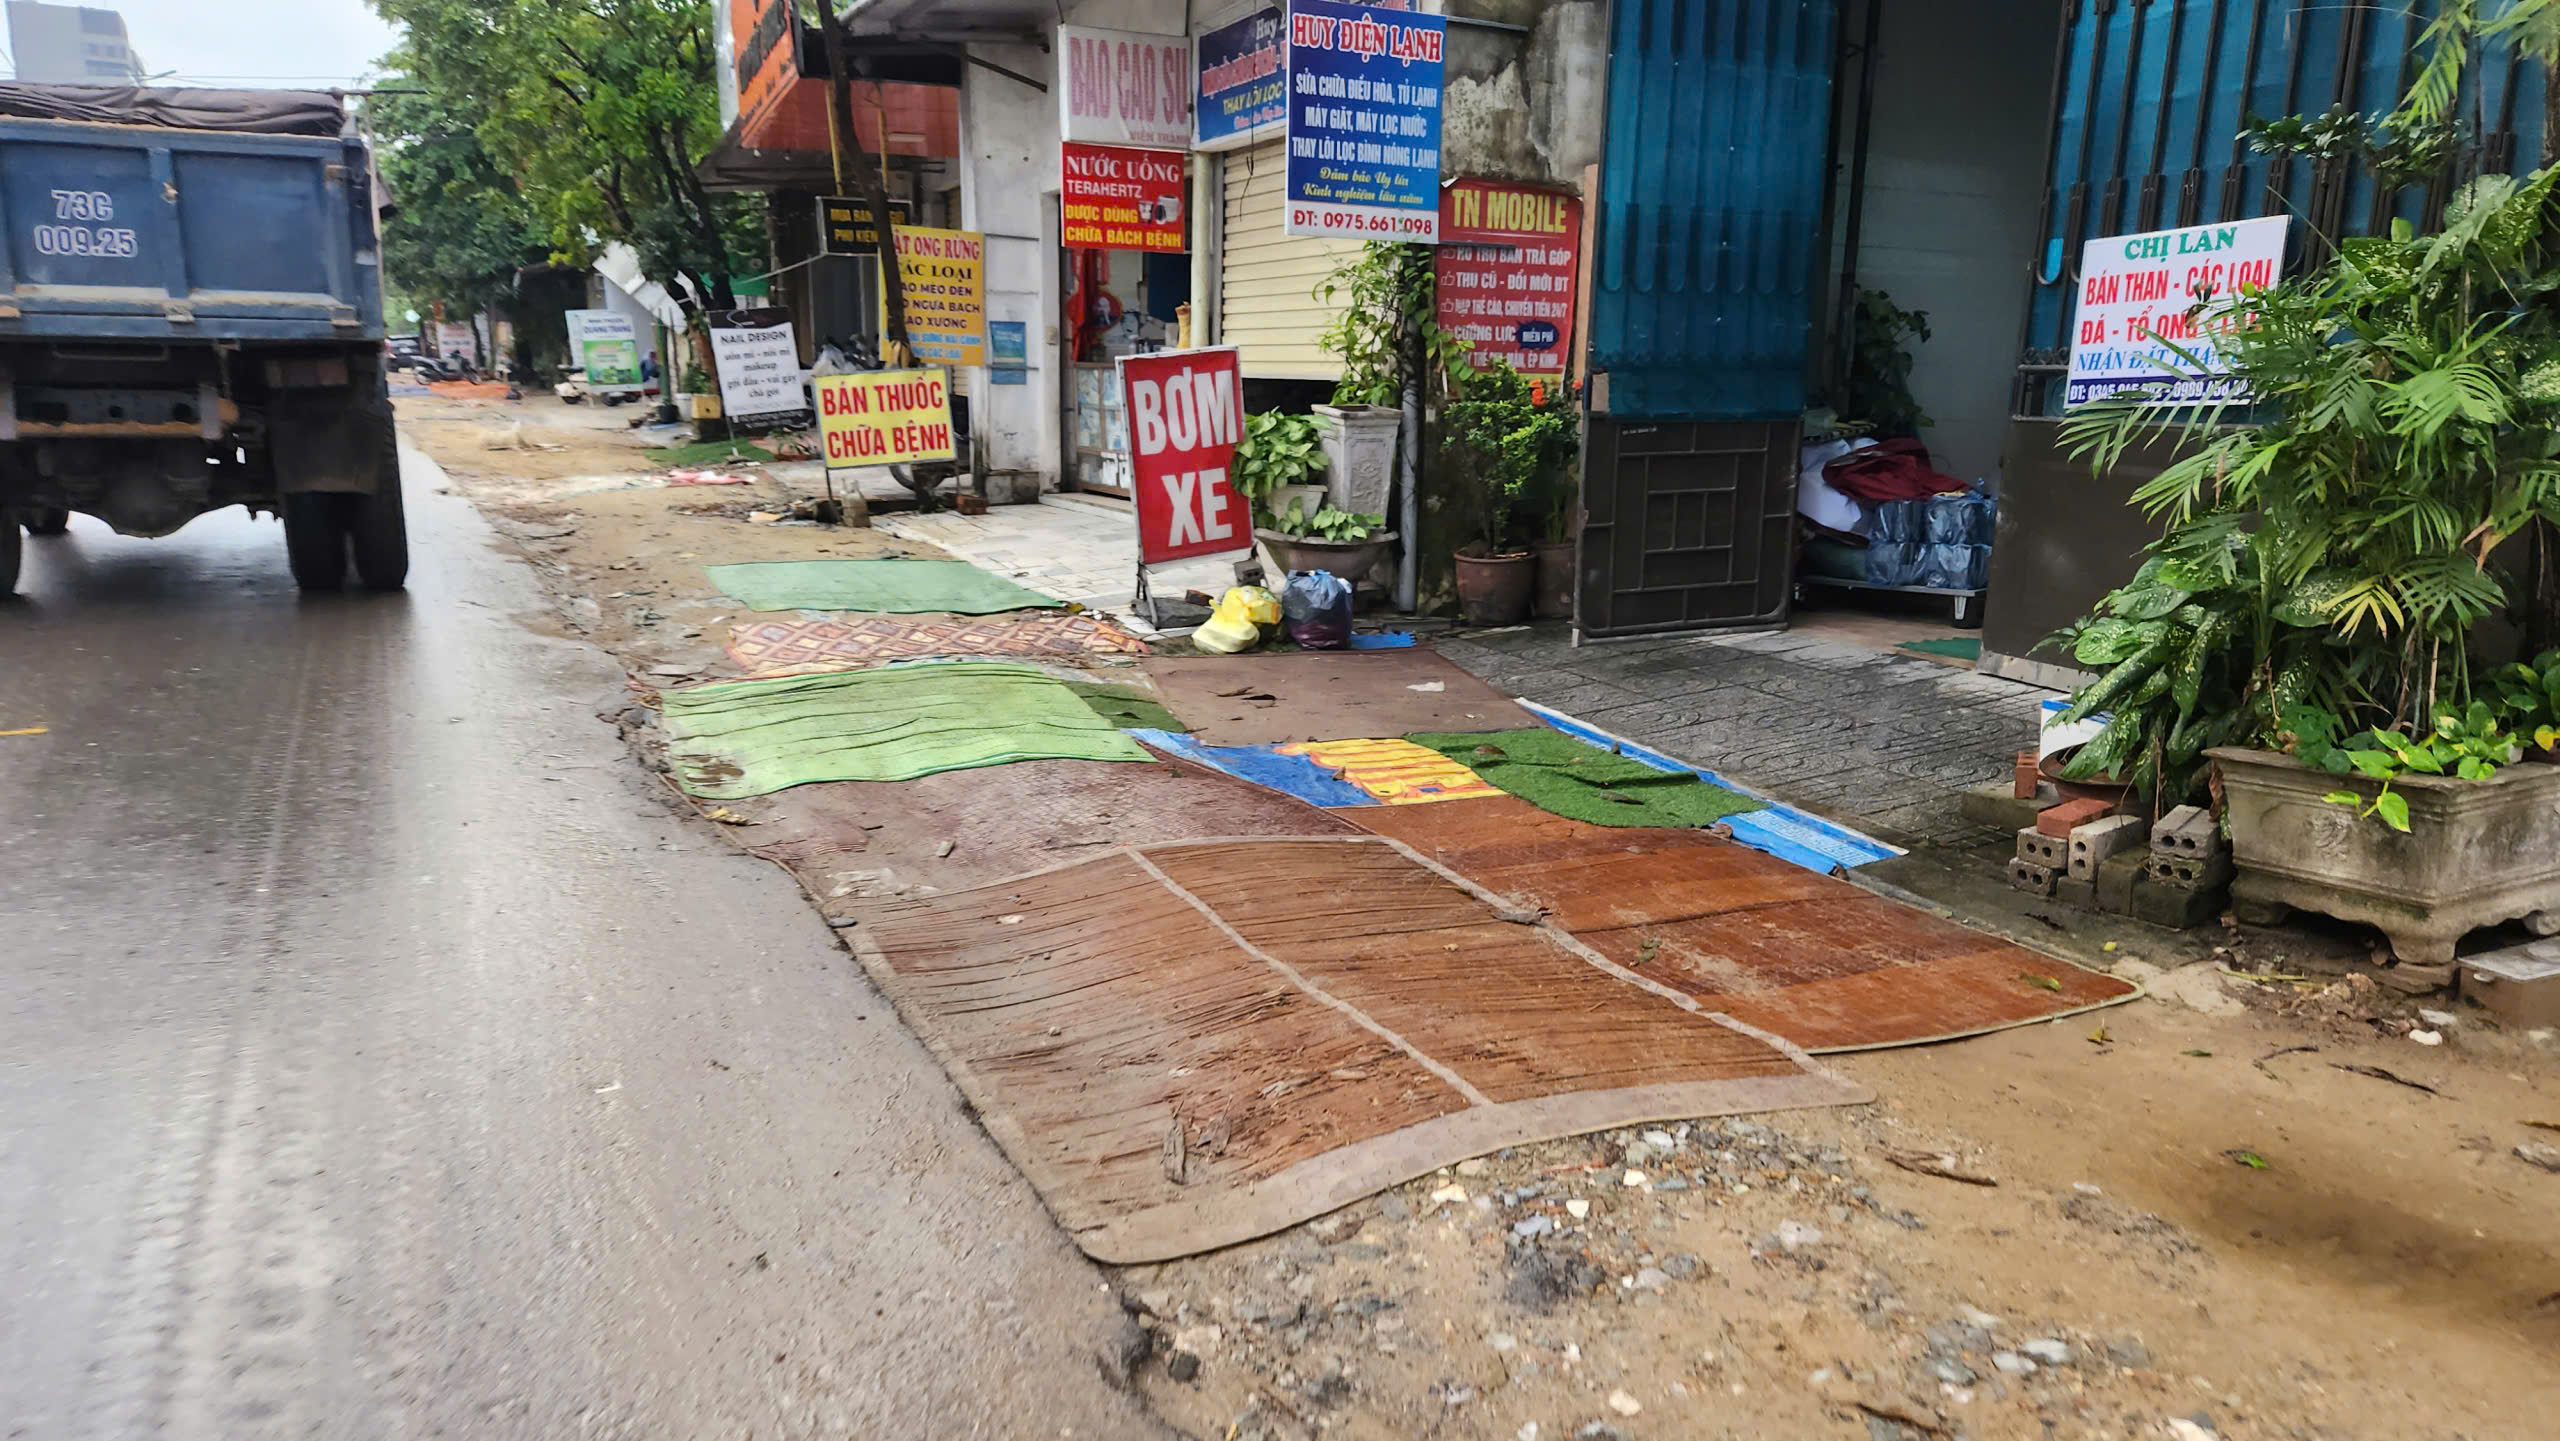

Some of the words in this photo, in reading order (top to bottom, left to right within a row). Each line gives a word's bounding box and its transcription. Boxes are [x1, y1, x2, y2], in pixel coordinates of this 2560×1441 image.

[1292, 12, 1337, 50] HUY
[1338, 12, 1388, 63] ĐIỆN
[1389, 24, 1444, 67] LẠNH
[1069, 37, 1111, 119] BAO
[1117, 42, 1155, 122] CAO
[1162, 47, 1187, 124] SU
[1296, 67, 1317, 95] SỬA
[1319, 73, 1346, 99] CHỮA
[1348, 73, 1371, 101] ĐIỀU
[1397, 78, 1411, 105] TỦ
[1412, 85, 1438, 111] LẠNH
[1305, 103, 1328, 127] MÁY
[1330, 105, 1354, 134] GIẶT,
[1356, 108, 1377, 133] MÁY
[1379, 113, 1399, 138] LỌC
[1400, 113, 1427, 137] NƯỚC
[1066, 153, 1121, 178] NƯỚC
[1127, 153, 1180, 183] UỐNG
[1292, 136, 1317, 158] THAY
[1336, 140, 1355, 165] LỌC
[1357, 139, 1381, 164] BÌNH
[1383, 142, 1410, 167] NÓNG
[1412, 148, 1438, 172] LẠNH
[51, 189, 114, 221] 73C
[1066, 180, 1143, 198] TERAHERTZ
[1065, 204, 1100, 223] ĐƯỢC
[1103, 206, 1139, 223] DÙNG
[1293, 209, 1318, 227] ĐT:
[1323, 211, 1433, 235] 0975.661.098
[1452, 189, 1480, 228] TN
[1486, 191, 1568, 233] MOBILE
[33, 224, 138, 258] 009.25
[914, 236, 941, 256] ONG
[1066, 226, 1103, 243] CHỮA
[1107, 228, 1143, 245] BÁCH
[1146, 230, 1182, 249] BỆNH
[2124, 234, 2170, 262] CHỊ
[2177, 226, 2237, 254] LAN
[1525, 244, 1546, 265] TRẢ
[1549, 247, 1572, 266] GÓP
[931, 265, 972, 283] LOẠI
[1456, 271, 1478, 289] THU
[1481, 270, 1497, 289] CŨ
[1507, 268, 1527, 290] ĐỔI
[1530, 272, 1552, 292] MỚI
[1554, 276, 1569, 292] ĐT
[2085, 270, 2120, 306] BÁN
[2124, 270, 2169, 302] THAN
[2185, 258, 2223, 298] CÁC
[720, 334, 745, 344] NAIL
[747, 330, 787, 342] DESIGN
[1455, 322, 1492, 341] CƯỜNG
[1495, 326, 1516, 344] LỰC
[2080, 314, 2105, 345] ĐÁ
[2127, 305, 2153, 342] TỔ
[2156, 313, 2198, 340] ONG
[2075, 347, 2127, 376] NHẬN
[822, 380, 869, 416] BÁN
[873, 371, 943, 412] THUỐC
[2070, 383, 2086, 400] ĐT:
[1133, 367, 1238, 456] BƠM
[827, 424, 887, 458] CHỮA
[892, 420, 950, 458] BỆNH
[1161, 467, 1233, 547] XE
